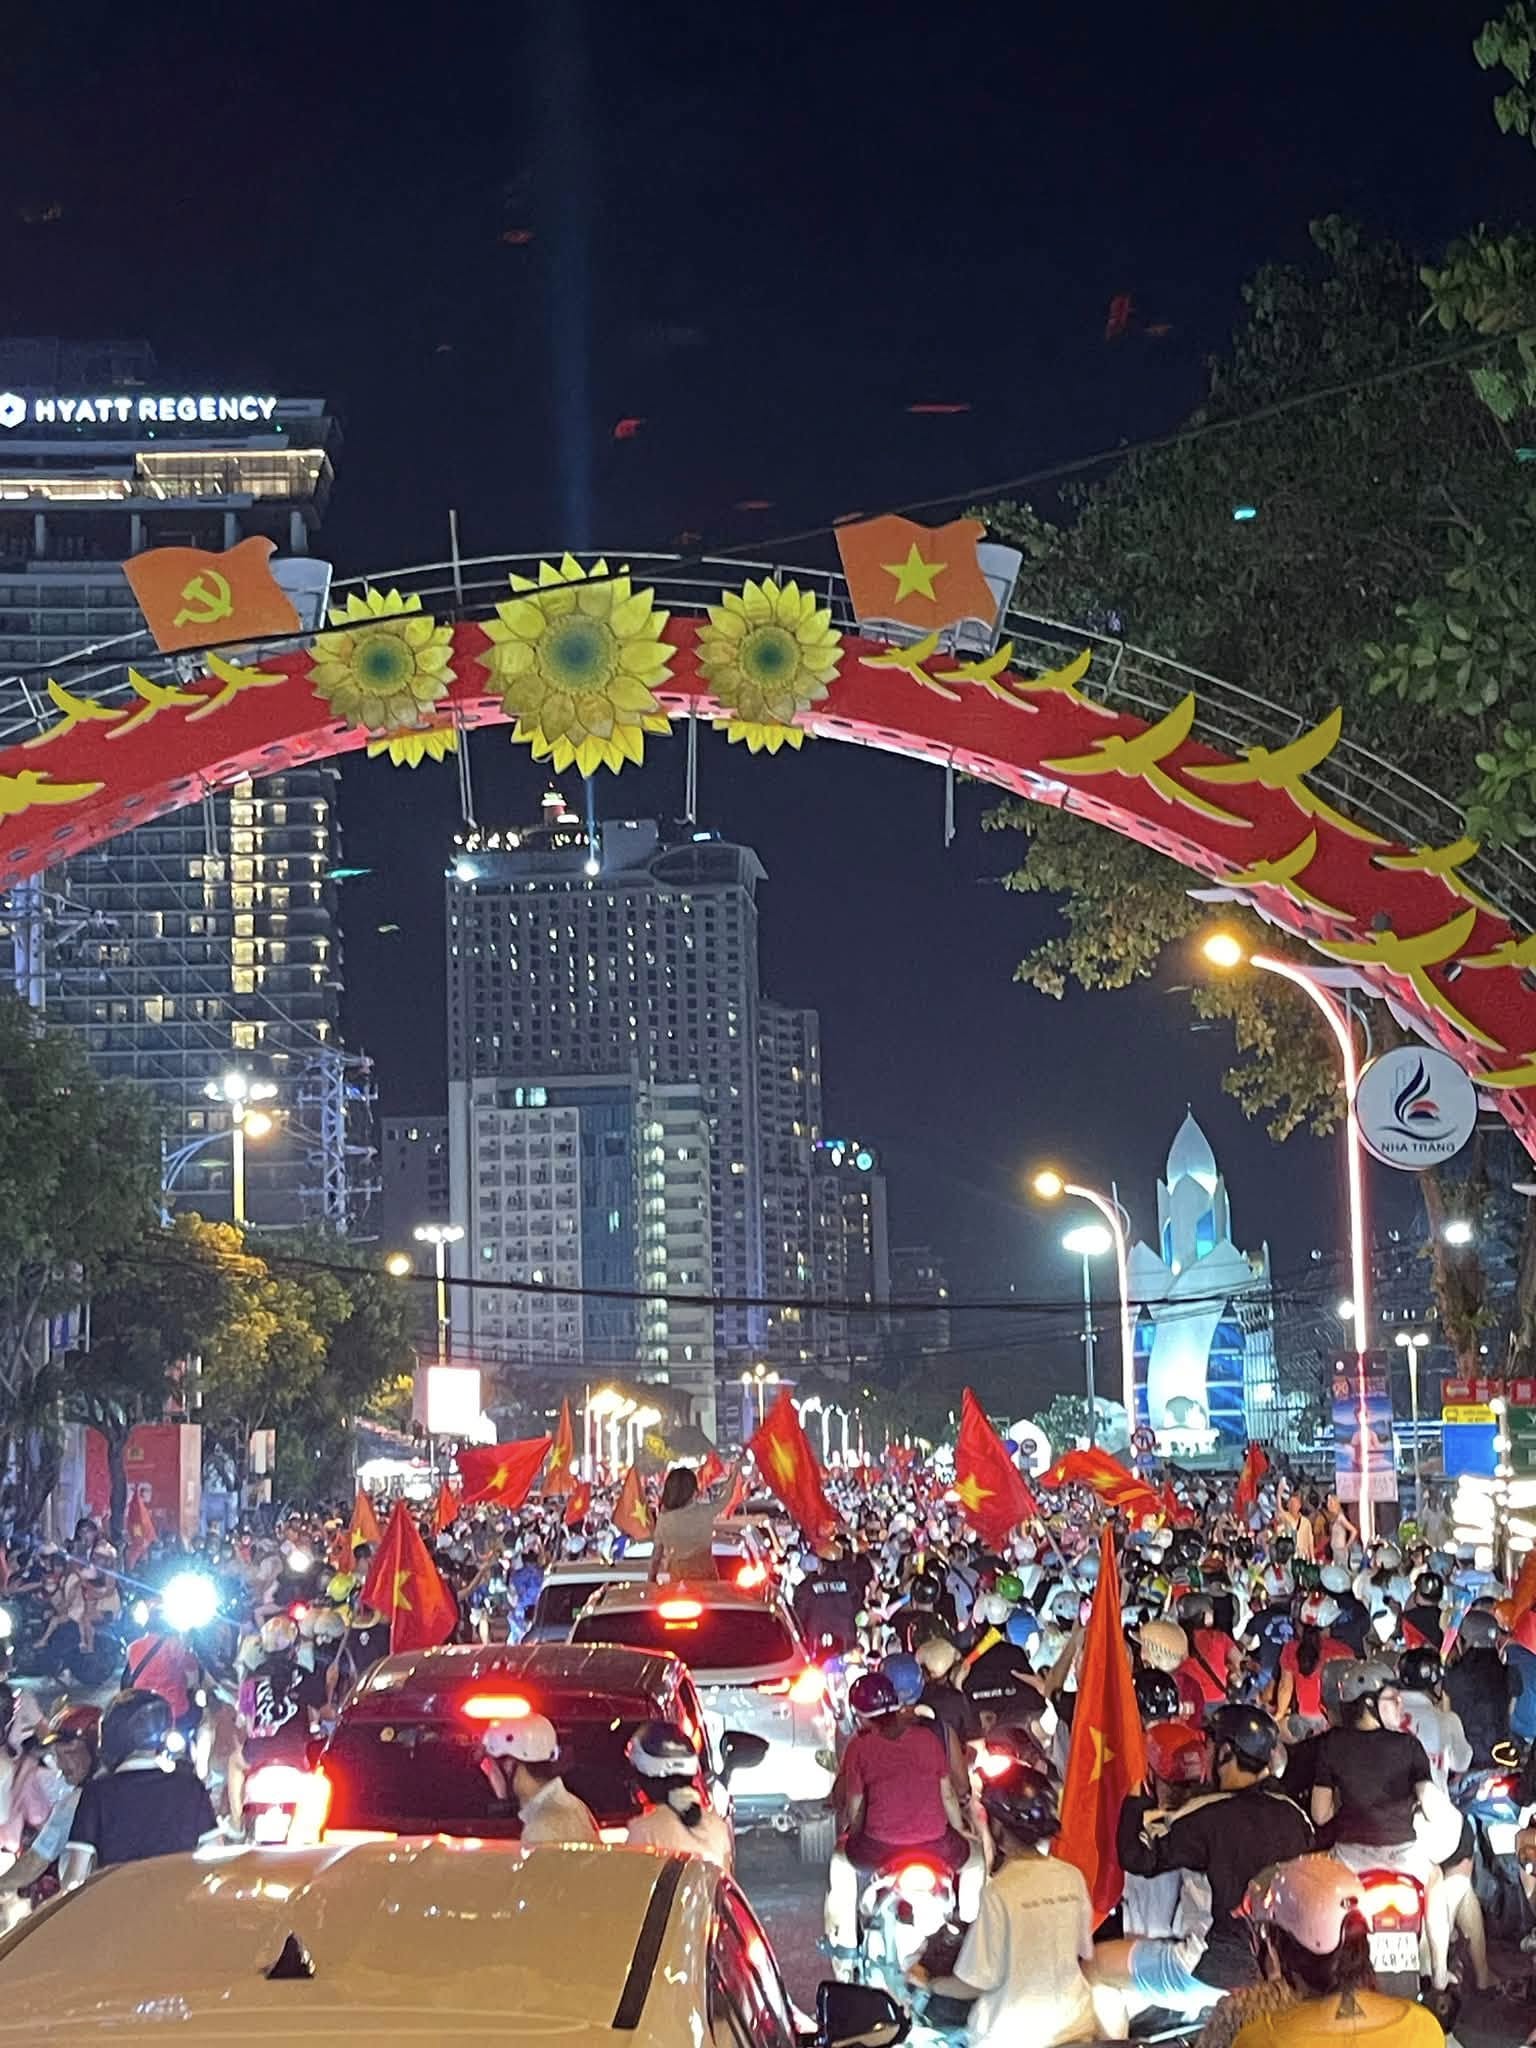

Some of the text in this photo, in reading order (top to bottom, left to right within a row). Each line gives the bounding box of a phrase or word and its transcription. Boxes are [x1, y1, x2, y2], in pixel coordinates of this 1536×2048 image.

[34, 396, 277, 423] HYATT REGENCY
[1381, 1142, 1409, 1153] NHA
